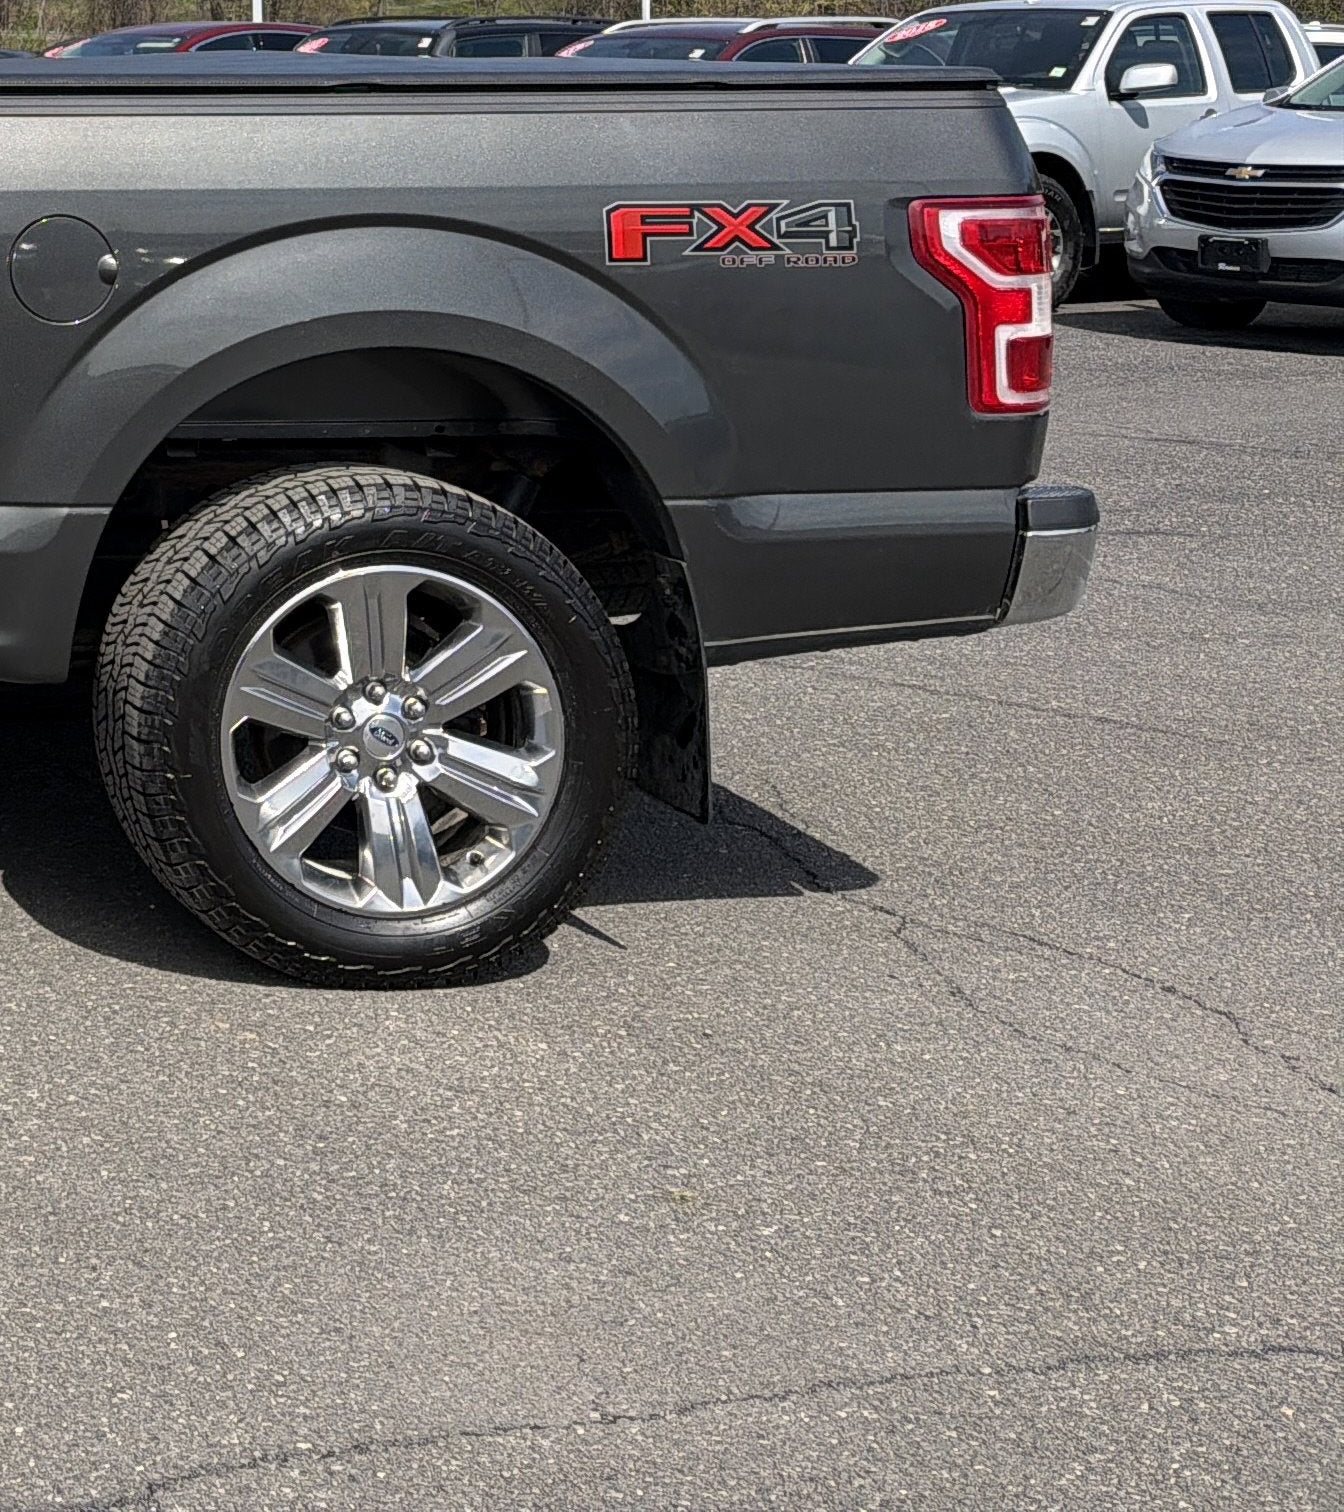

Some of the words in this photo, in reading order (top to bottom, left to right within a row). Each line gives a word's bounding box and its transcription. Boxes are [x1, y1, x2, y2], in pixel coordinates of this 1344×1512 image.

[603, 199, 861, 265] FX4
[720, 254, 775, 267] OFF
[784, 253, 859, 267] ROAD
